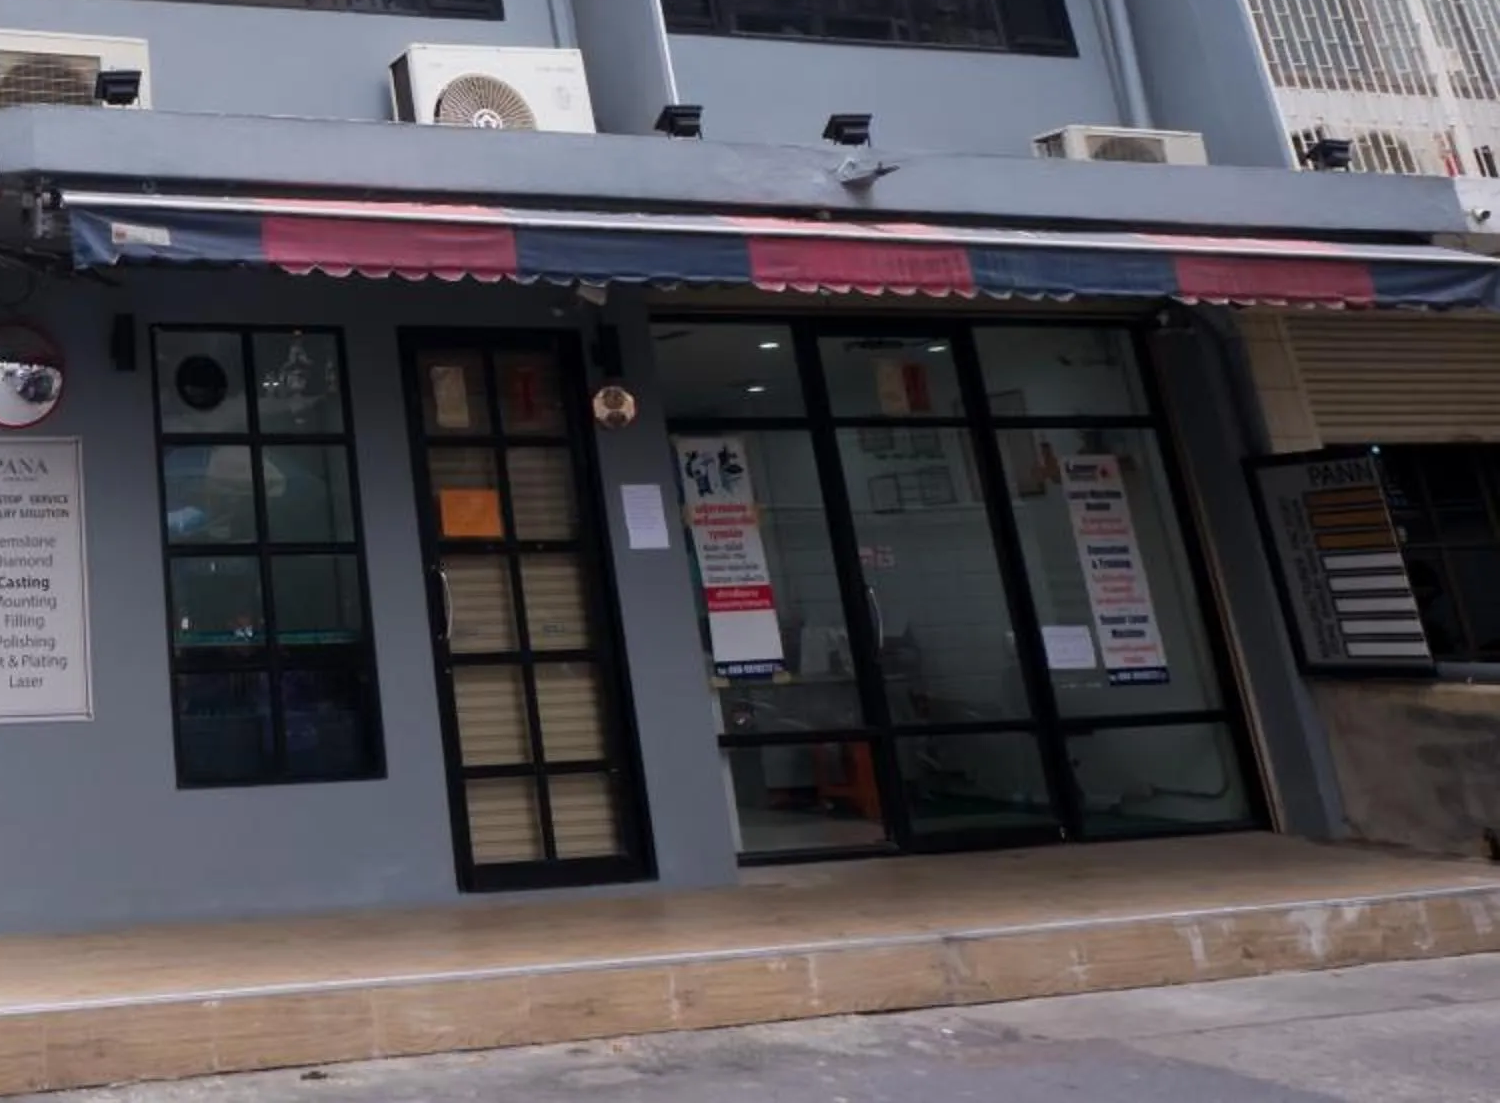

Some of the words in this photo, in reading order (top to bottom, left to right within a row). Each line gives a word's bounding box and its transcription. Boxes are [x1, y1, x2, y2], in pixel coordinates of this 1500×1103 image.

[19, 507, 70, 519] SOLUTION
[3, 613, 46, 631] Filling
[7, 654, 19, 669] &
[20, 653, 69, 671] Plating
